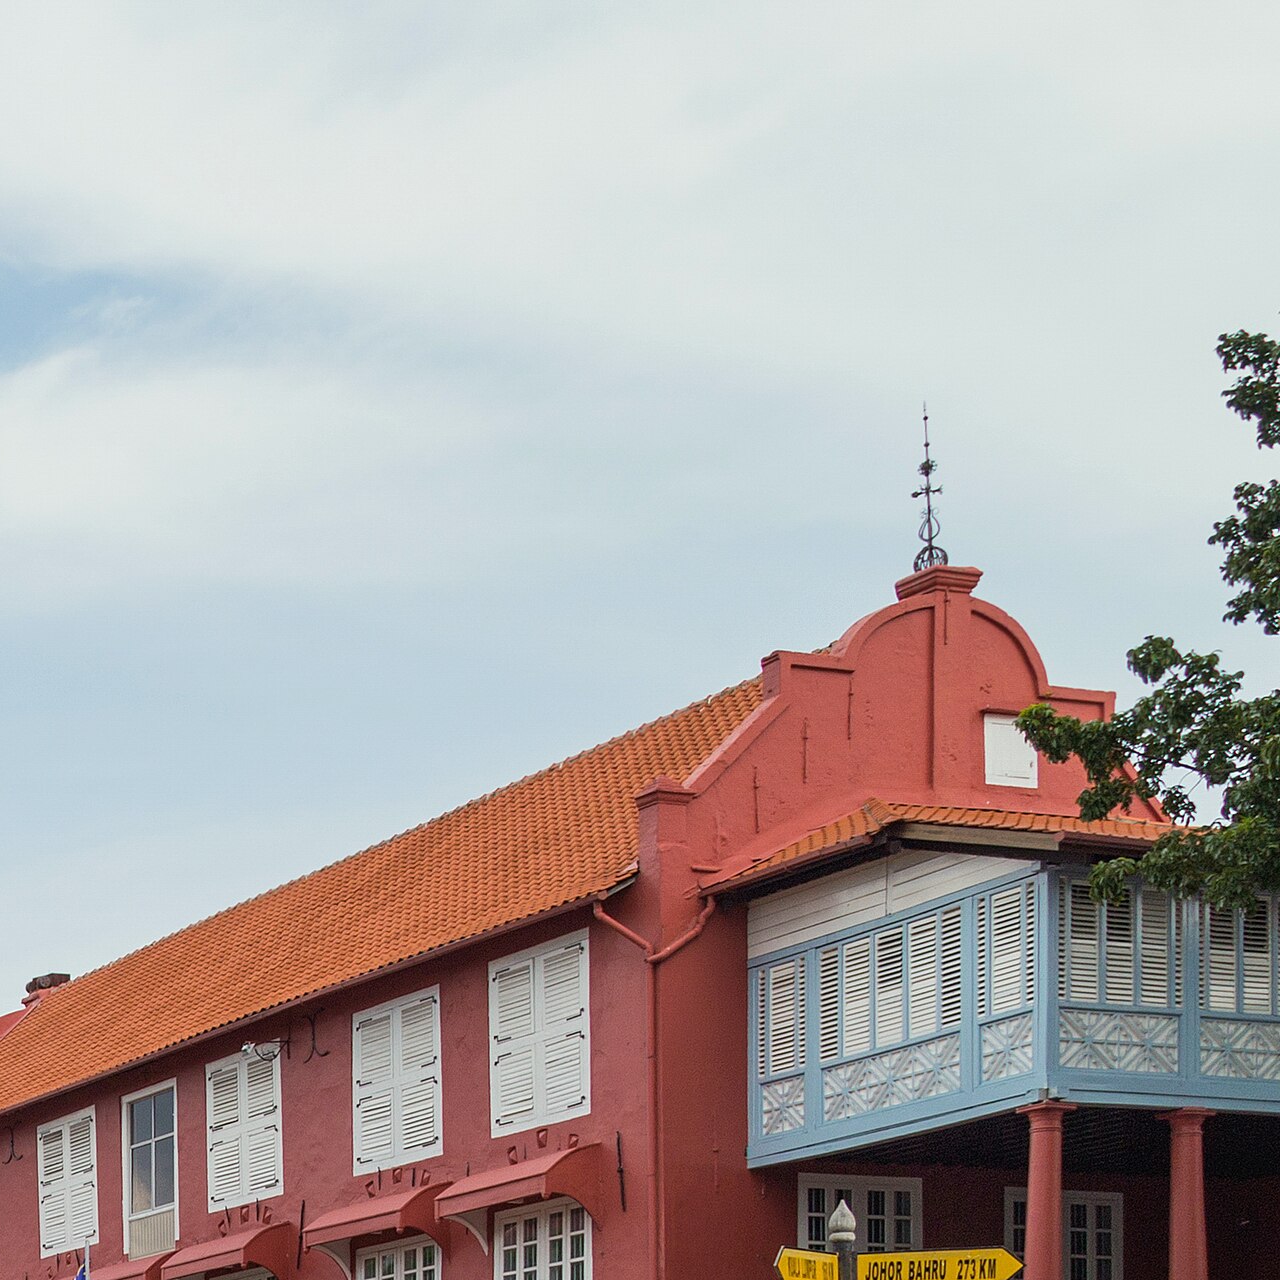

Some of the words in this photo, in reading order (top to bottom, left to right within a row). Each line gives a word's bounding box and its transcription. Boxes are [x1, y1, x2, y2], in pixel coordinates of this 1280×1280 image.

[908, 1259, 947, 1280] BAHRU
[957, 1259, 976, 1280] 273
[979, 1258, 997, 1280] KM
